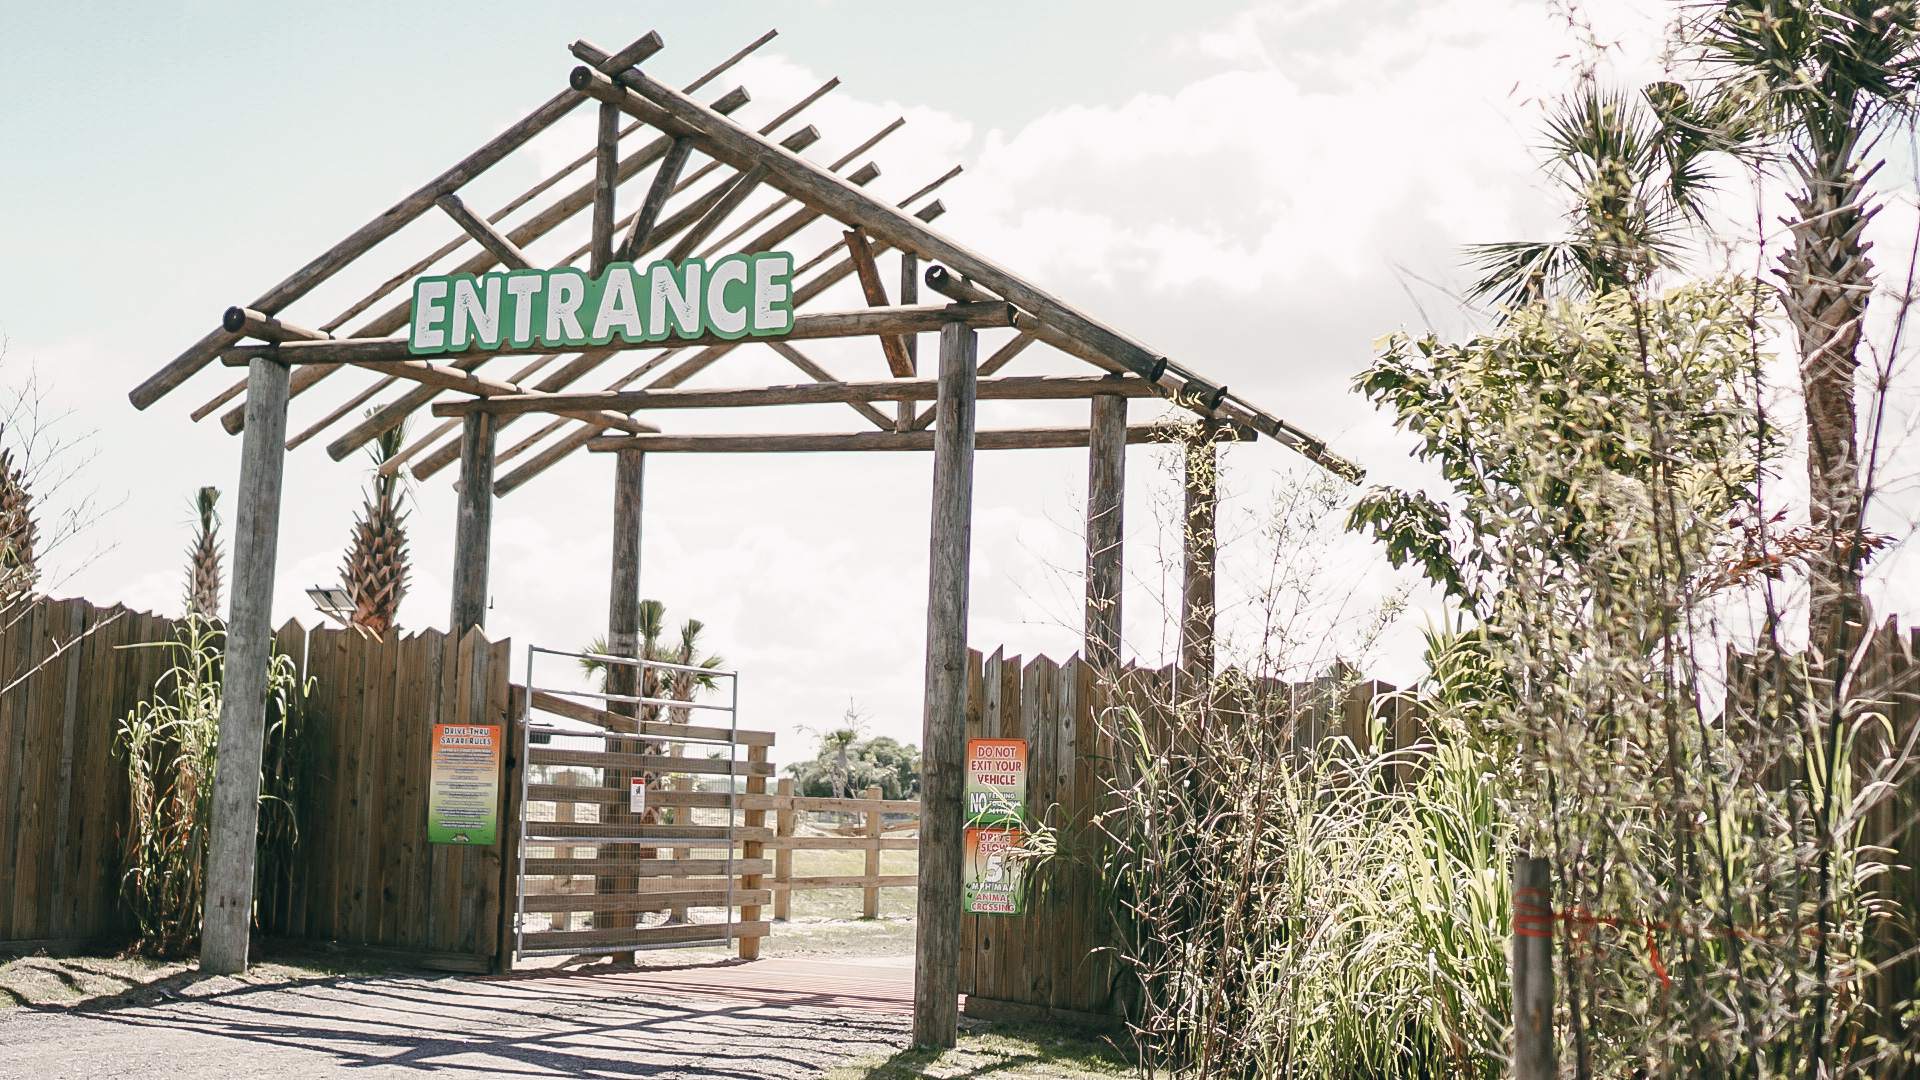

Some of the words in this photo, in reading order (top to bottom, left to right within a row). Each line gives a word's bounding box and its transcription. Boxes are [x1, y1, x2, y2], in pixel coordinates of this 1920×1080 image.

[414, 257, 788, 348] ENTRANCE
[444, 727, 489, 736] DRIVE-THRU
[441, 736, 467, 744] SAFARI
[469, 737, 491, 745] RULES
[978, 746, 993, 758] DO
[995, 747, 1016, 758] NOT
[971, 760, 992, 771] EXIT
[995, 761, 1022, 772] YOUR
[977, 774, 1016, 785] VEHICLE
[970, 792, 987, 813] NO
[986, 855, 1003, 883] 5
[975, 893, 1011, 902] ANIMAL
[971, 902, 1015, 912] CROSSING
